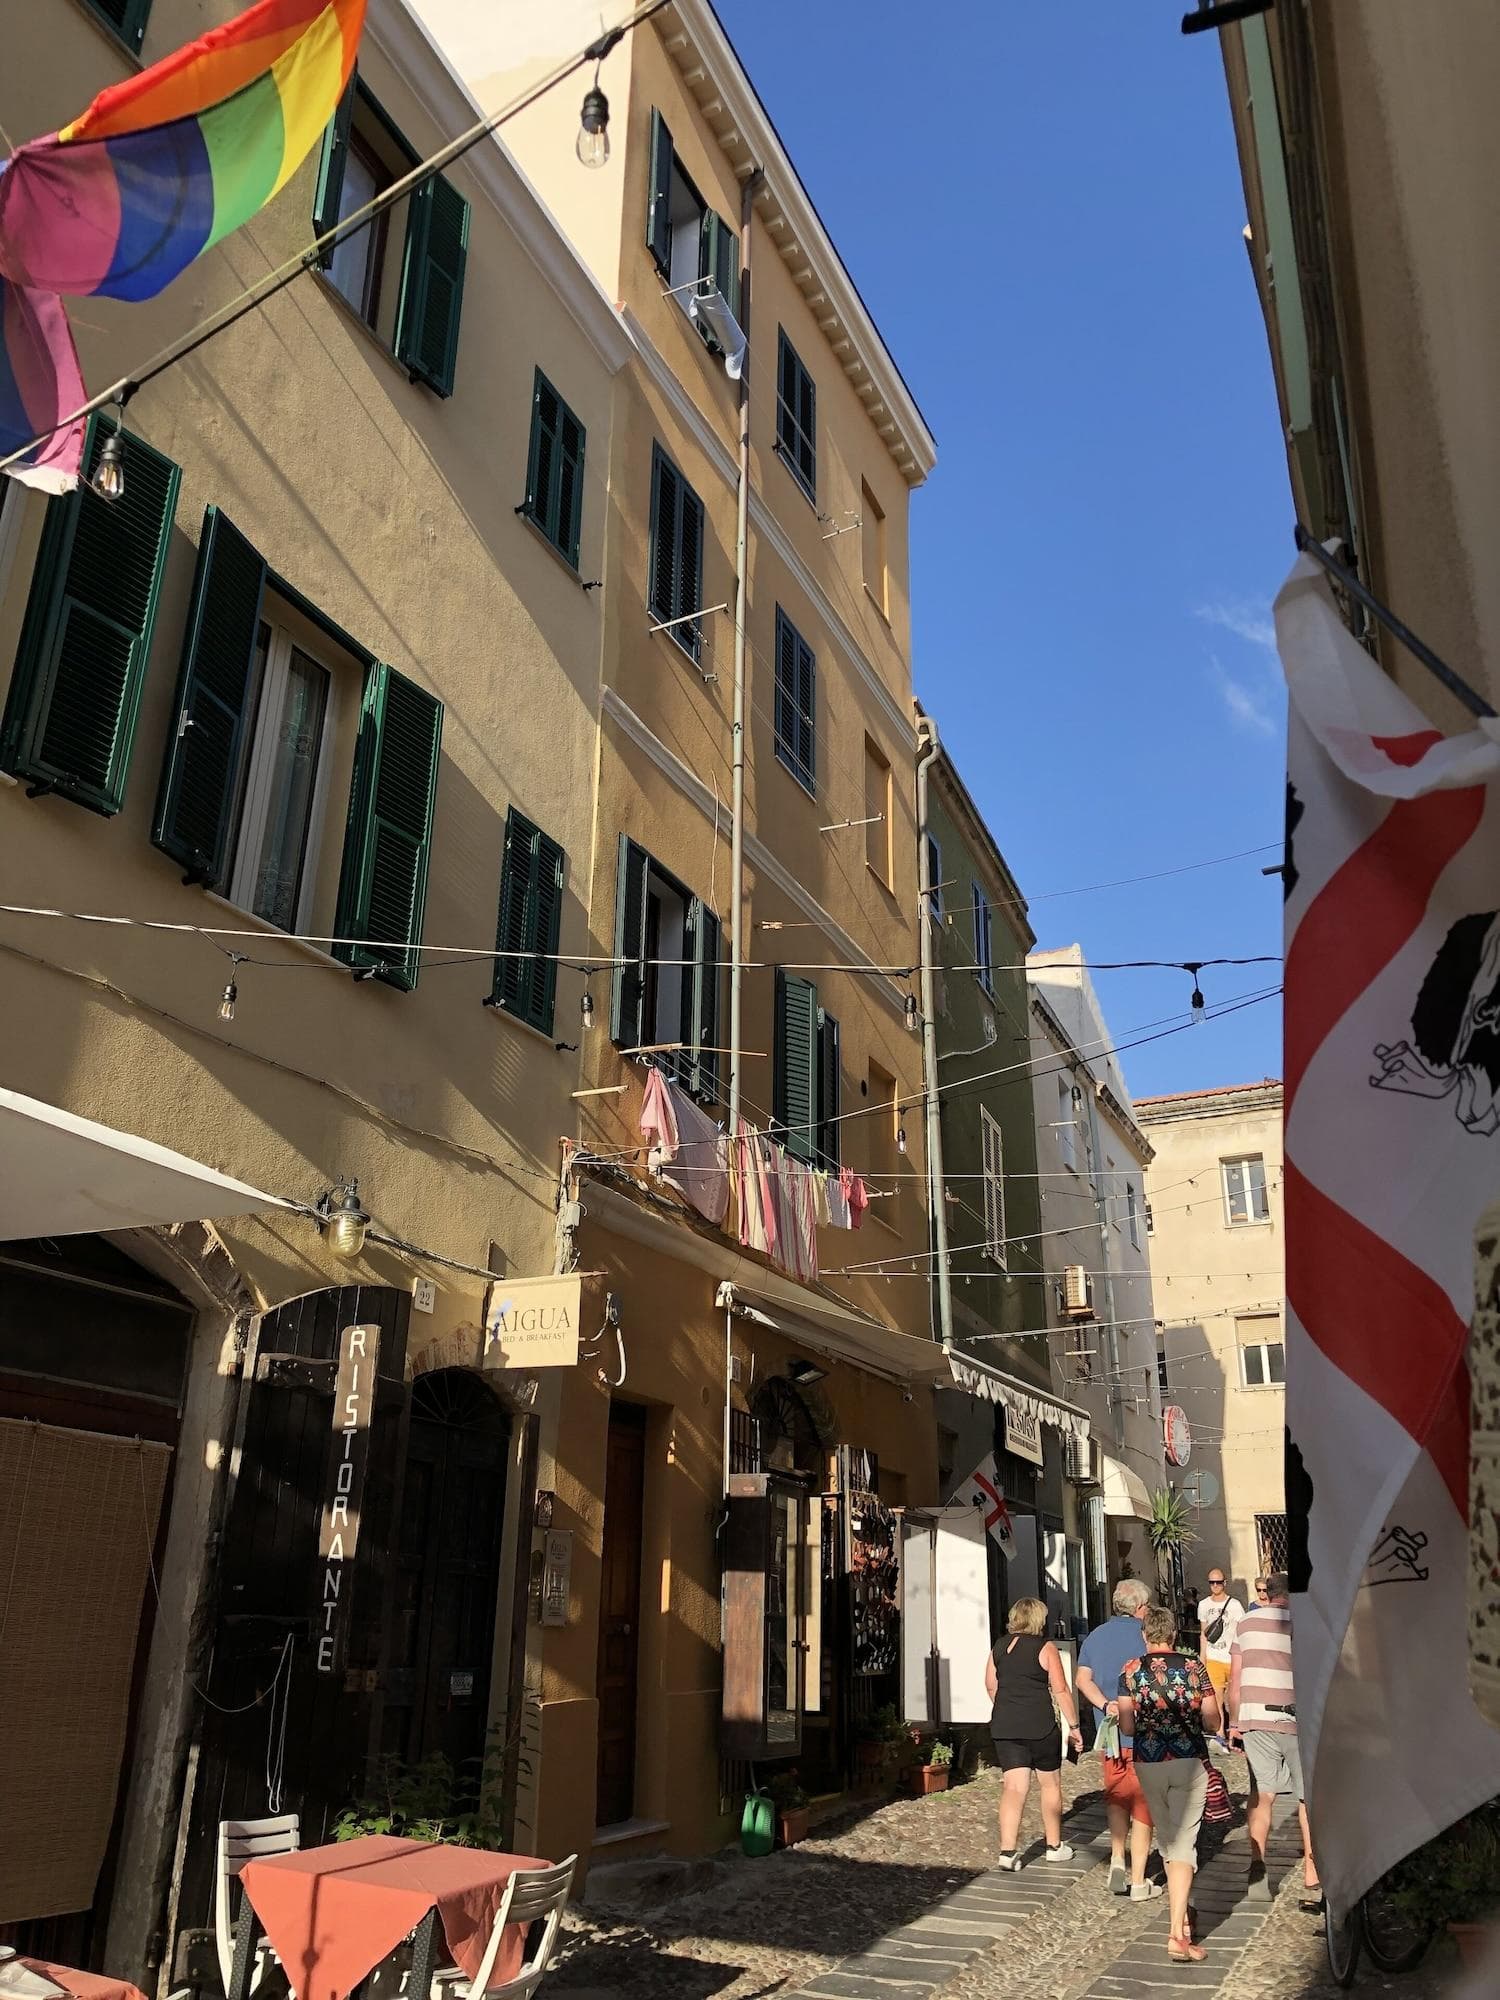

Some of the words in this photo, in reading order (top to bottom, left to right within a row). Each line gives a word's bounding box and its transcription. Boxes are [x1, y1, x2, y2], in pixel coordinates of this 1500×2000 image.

[419, 1290, 431, 1306] 22
[502, 1335, 516, 1343] BED
[526, 1332, 567, 1342] BREAKFAST
[317, 1329, 366, 1672] RISTORANTE
